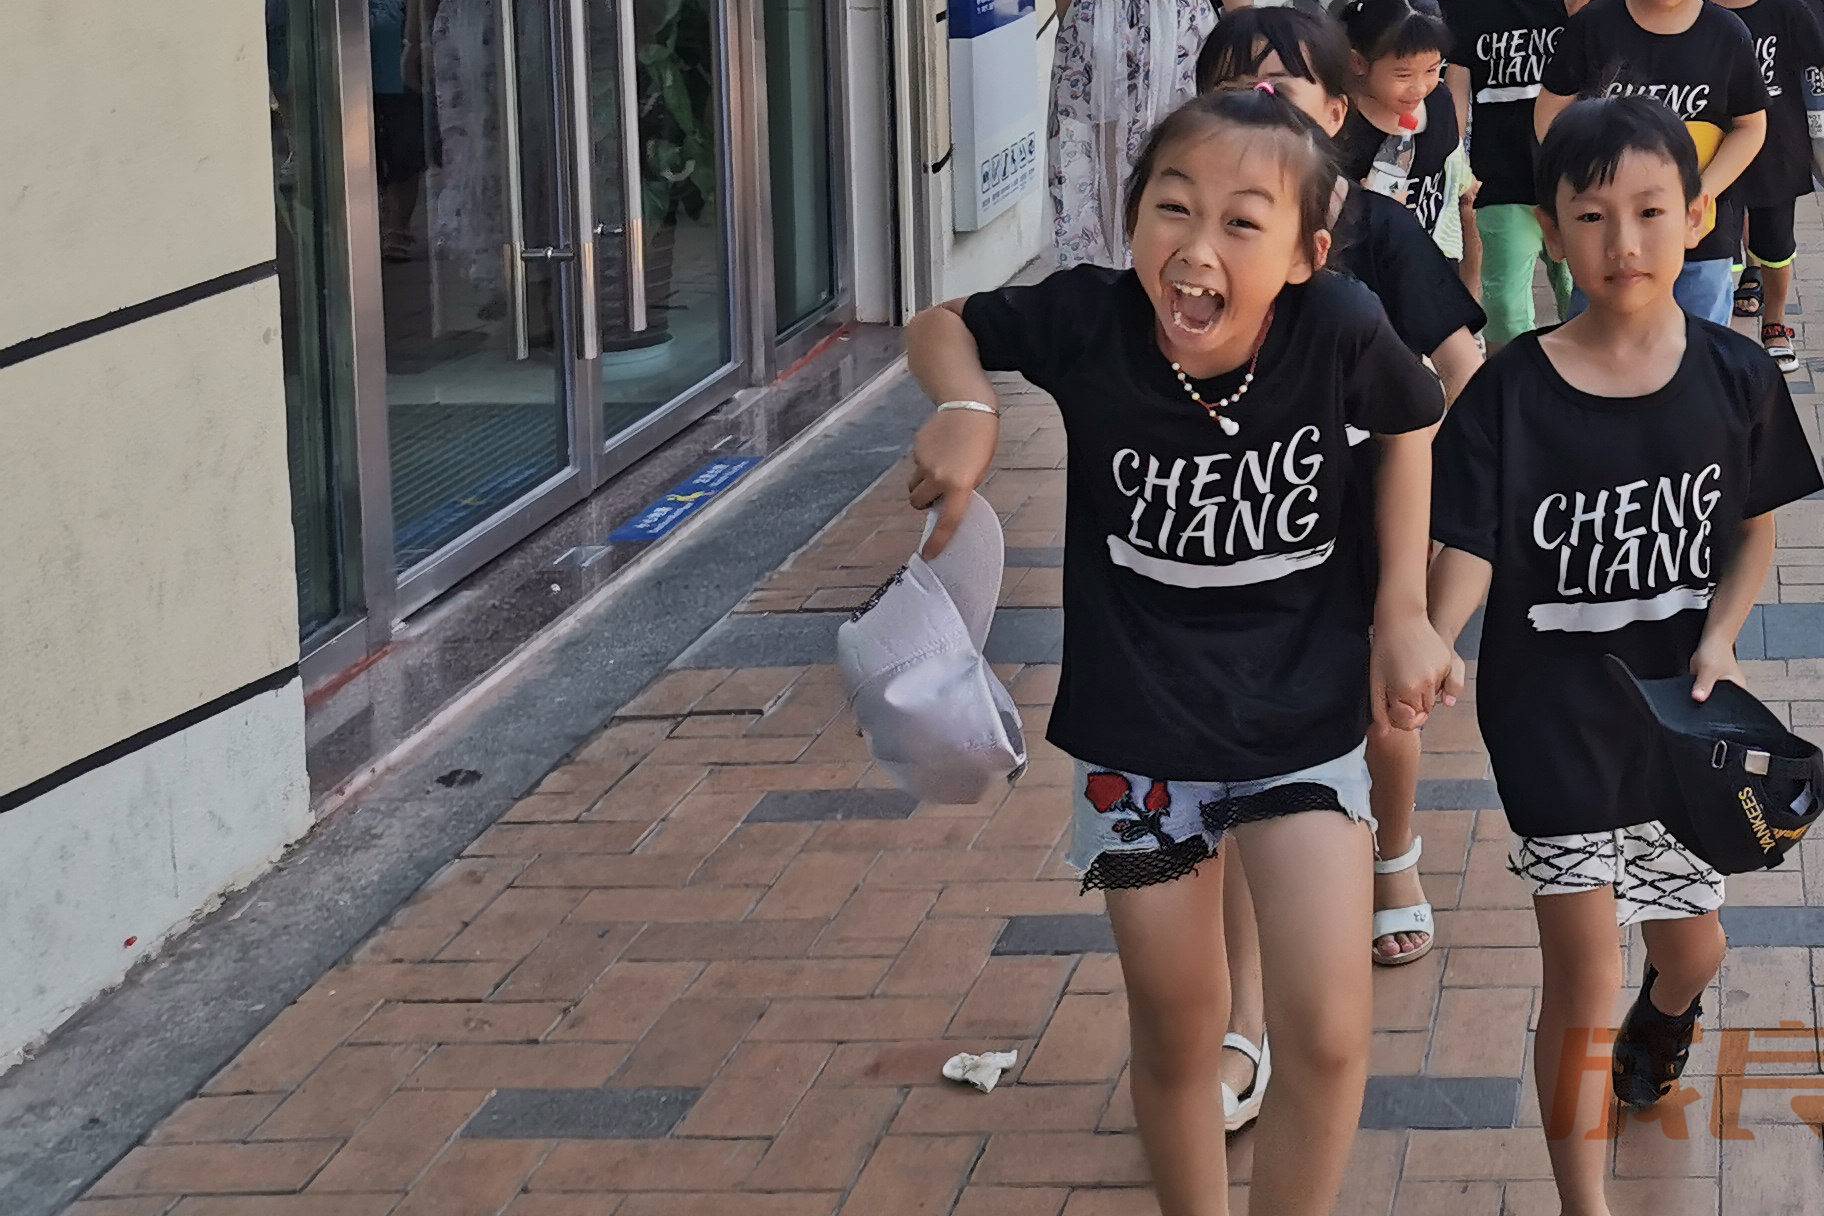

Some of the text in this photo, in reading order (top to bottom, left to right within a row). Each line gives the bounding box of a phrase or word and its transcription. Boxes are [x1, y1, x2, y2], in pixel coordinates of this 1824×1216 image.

[1487, 55, 1552, 85] LIAN
[1112, 425, 1324, 509] CHENG
[1128, 484, 1320, 558] LIANG
[1533, 463, 1722, 550] CHENG
[1557, 519, 1711, 596] LIANG
[1738, 786, 1776, 855] YANKEES
